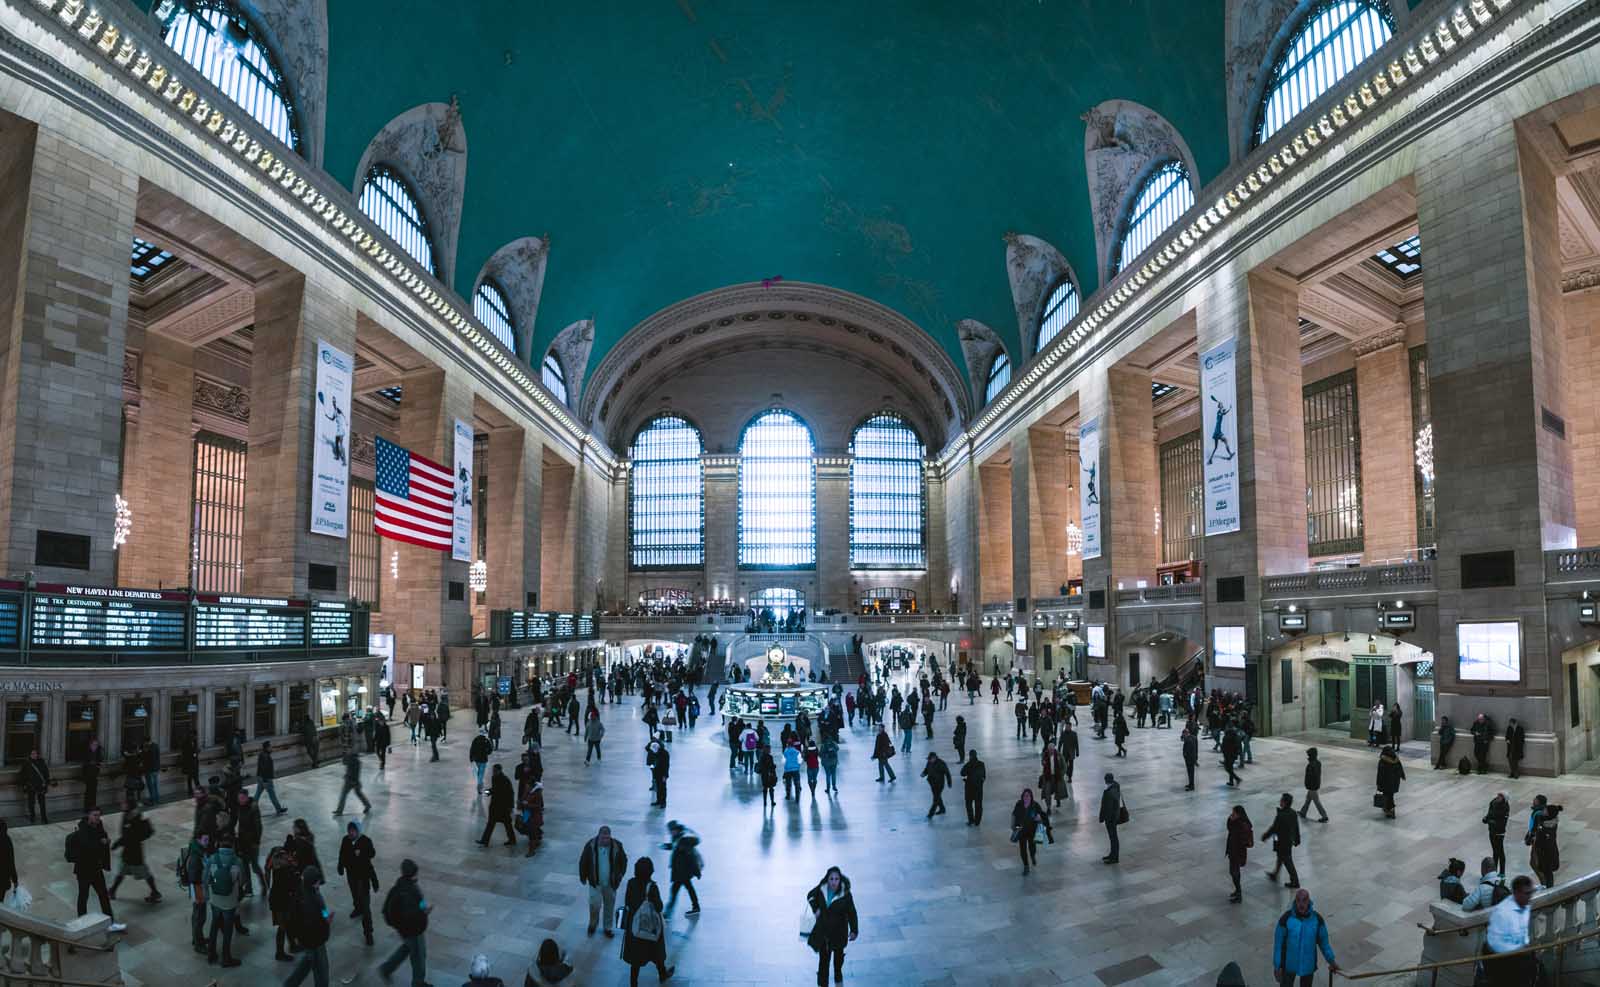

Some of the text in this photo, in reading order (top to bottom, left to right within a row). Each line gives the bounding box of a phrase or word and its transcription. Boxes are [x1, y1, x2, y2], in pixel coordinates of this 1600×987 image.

[66, 586, 162, 599] NEW HAVEN LINE DEPARTURES
